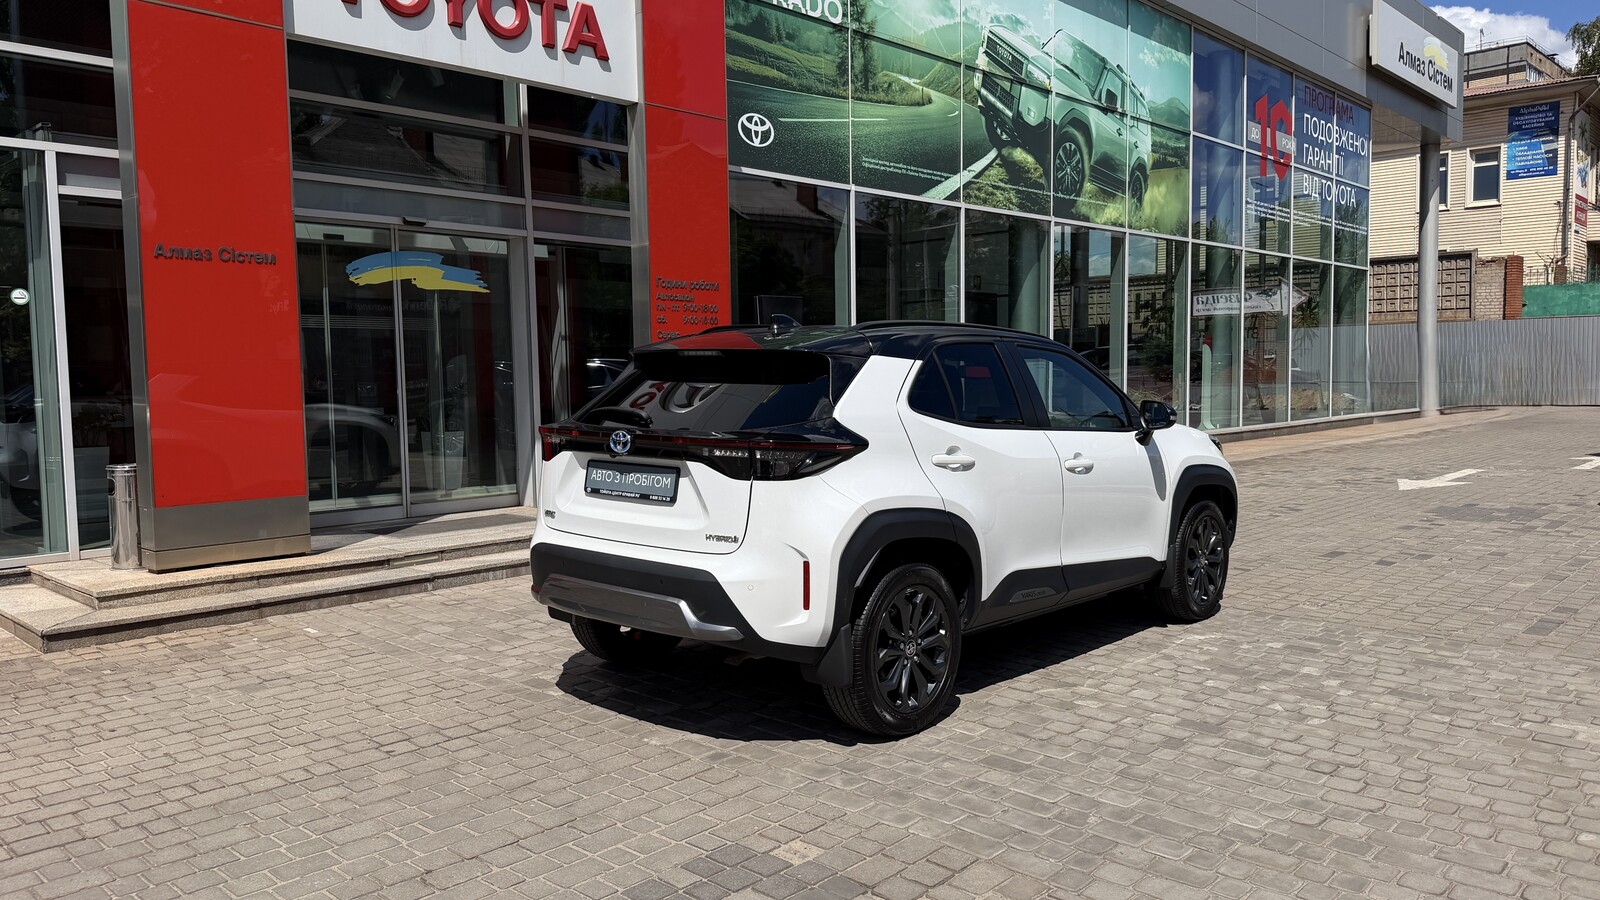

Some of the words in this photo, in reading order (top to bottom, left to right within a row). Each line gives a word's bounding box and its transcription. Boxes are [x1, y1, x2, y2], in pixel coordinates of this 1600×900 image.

[1398, 42, 1426, 77] Алмаз
[1427, 59, 1453, 93] Сістем
[1304, 85, 1355, 126] ПРОГРАМА
[1251, 127, 1260, 139] ДО
[1303, 113, 1368, 157] ПОДОВЖЕНОЇ
[1282, 138, 1297, 152] РОКВ
[1303, 143, 1344, 175] ГАРАНТІЇ
[1303, 173, 1319, 201] ВІД
[1321, 179, 1357, 208] TOYOTA
[154, 242, 212, 261] Алмаз
[218, 246, 276, 265] Сістем
[656, 276, 687, 290] Години
[690, 280, 719, 292] роботи
[656, 291, 694, 302] Автосалон
[591, 469, 613, 483] АВТО
[622, 473, 671, 489] ПРОБІГОМ
